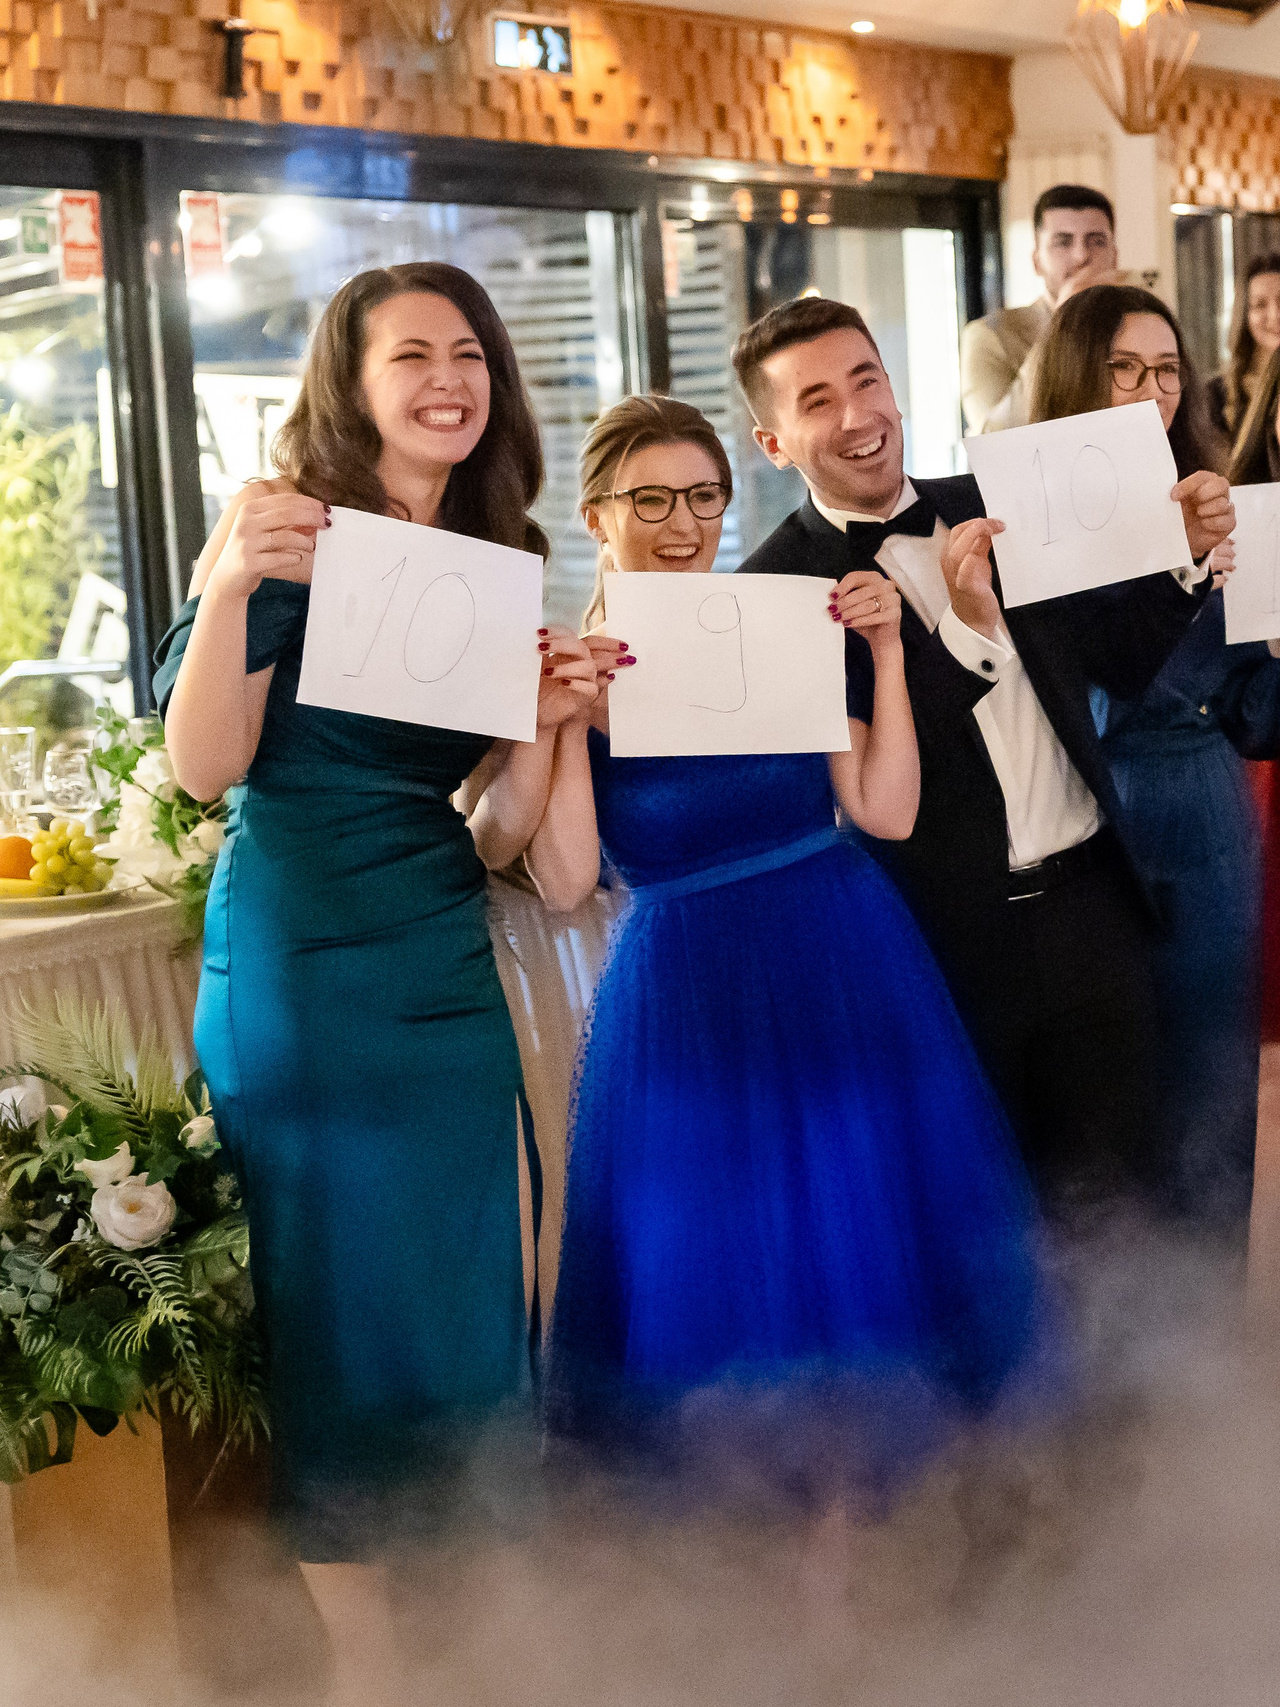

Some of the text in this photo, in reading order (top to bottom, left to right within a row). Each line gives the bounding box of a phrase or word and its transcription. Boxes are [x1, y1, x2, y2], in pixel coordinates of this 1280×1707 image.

[1032, 444, 1120, 547] 10
[343, 556, 475, 684] 10
[690, 592, 747, 713] 9
